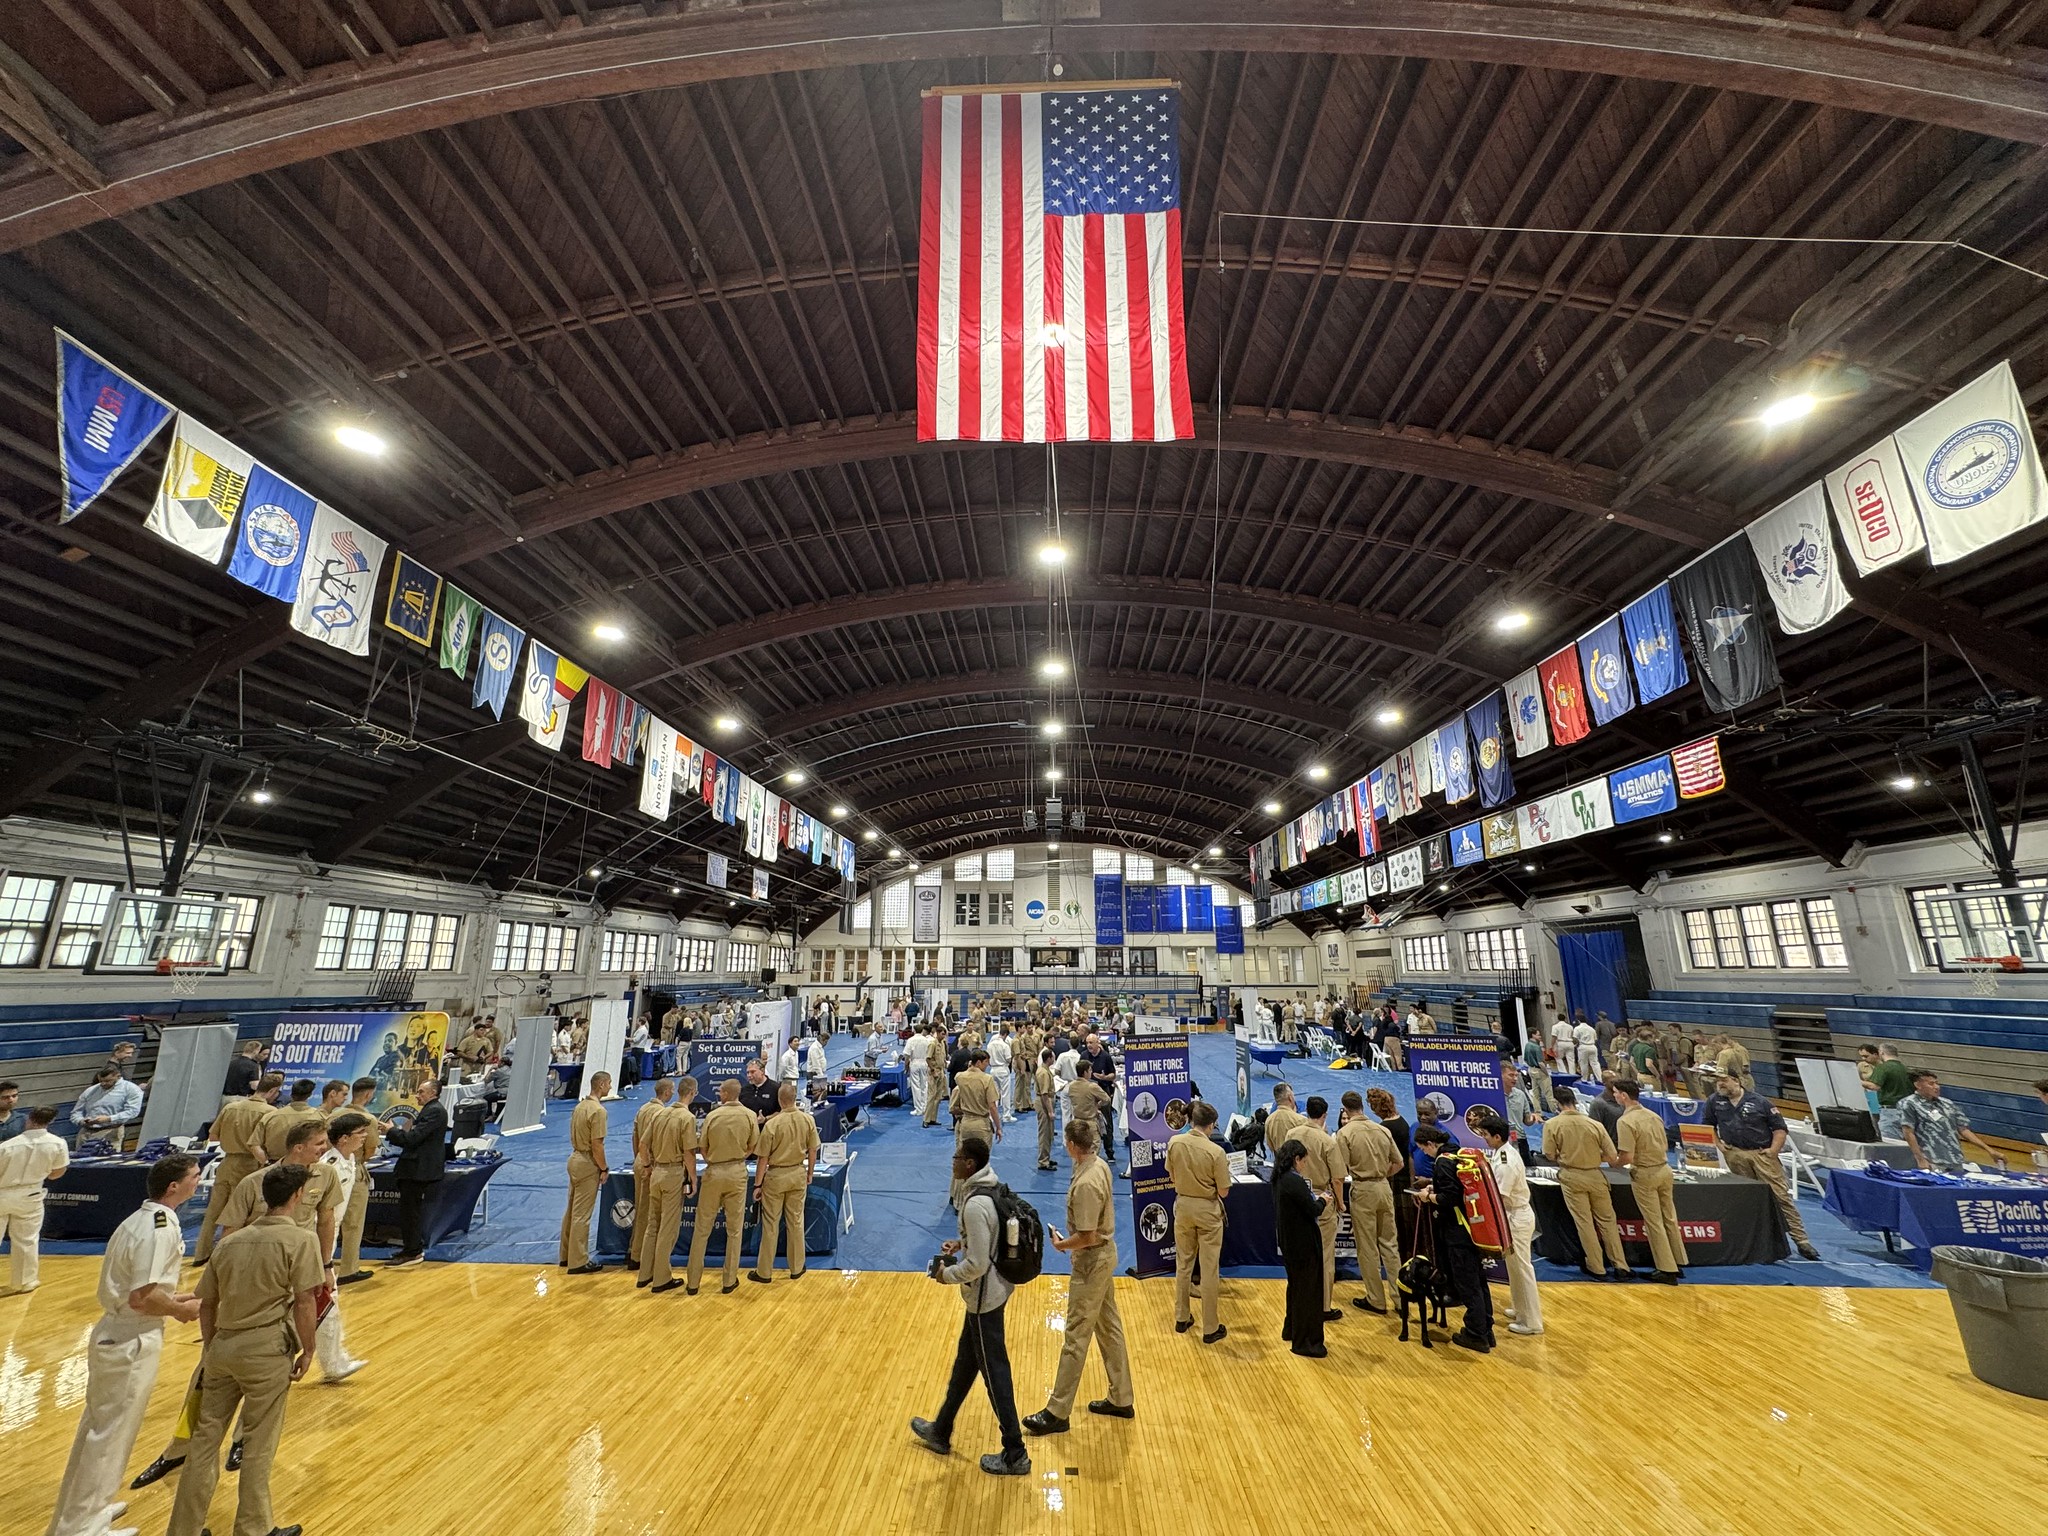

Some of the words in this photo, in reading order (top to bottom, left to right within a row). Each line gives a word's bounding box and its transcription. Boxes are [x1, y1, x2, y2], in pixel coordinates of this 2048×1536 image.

[84, 385, 125, 453] USMMI
[1935, 425, 1995, 462] OCEANOGRAPHIC
[1995, 425, 2018, 461] LABORATORY
[1955, 460, 1996, 487] UNOLS
[1992, 462, 2015, 491] SYSTEM
[208, 464, 232, 509] MARINE
[1855, 480, 1890, 542] SEDCO
[453, 613, 466, 650] Kirby
[655, 733, 668, 809] NORWEGIAN
[1617, 769, 1670, 800] USMMA
[1627, 788, 1664, 804] ATHLETICS
[274, 1023, 363, 1042] OPPORTUNITY
[269, 1044, 284, 1063] IS
[285, 1044, 312, 1063] OUT
[312, 1045, 346, 1064] HERE
[698, 1043, 713, 1053] Set
[722, 1043, 757, 1053] Course
[1125, 1042, 1165, 1050] PHILADELPHIA
[1410, 1042, 1462, 1051] PHILADELPHIA
[1463, 1044, 1497, 1052] DIVISION
[707, 1054, 723, 1064] for
[723, 1056, 746, 1065] your
[1132, 1060, 1148, 1072] JOIN
[1148, 1059, 1162, 1071] THE
[1163, 1058, 1184, 1070] FORCE
[1420, 1059, 1440, 1072] JOIN
[1441, 1060, 1460, 1073] THE
[1461, 1062, 1491, 1075] FORCE
[709, 1066, 742, 1075] Career
[1128, 1074, 1154, 1087] BEHIND
[1155, 1073, 1169, 1085] THE
[1169, 1071, 1188, 1084] FLEET
[1416, 1074, 1449, 1087] BEHIND
[1450, 1075, 1470, 1088] THE
[1471, 1077, 1499, 1090] FLEET
[1153, 1141, 1167, 1150] See
[1154, 1151, 1162, 1160] at
[67, 1193, 99, 1201] COMMAND
[1995, 1200, 2041, 1220] Pacific
[1617, 1224, 1636, 1236] AE
